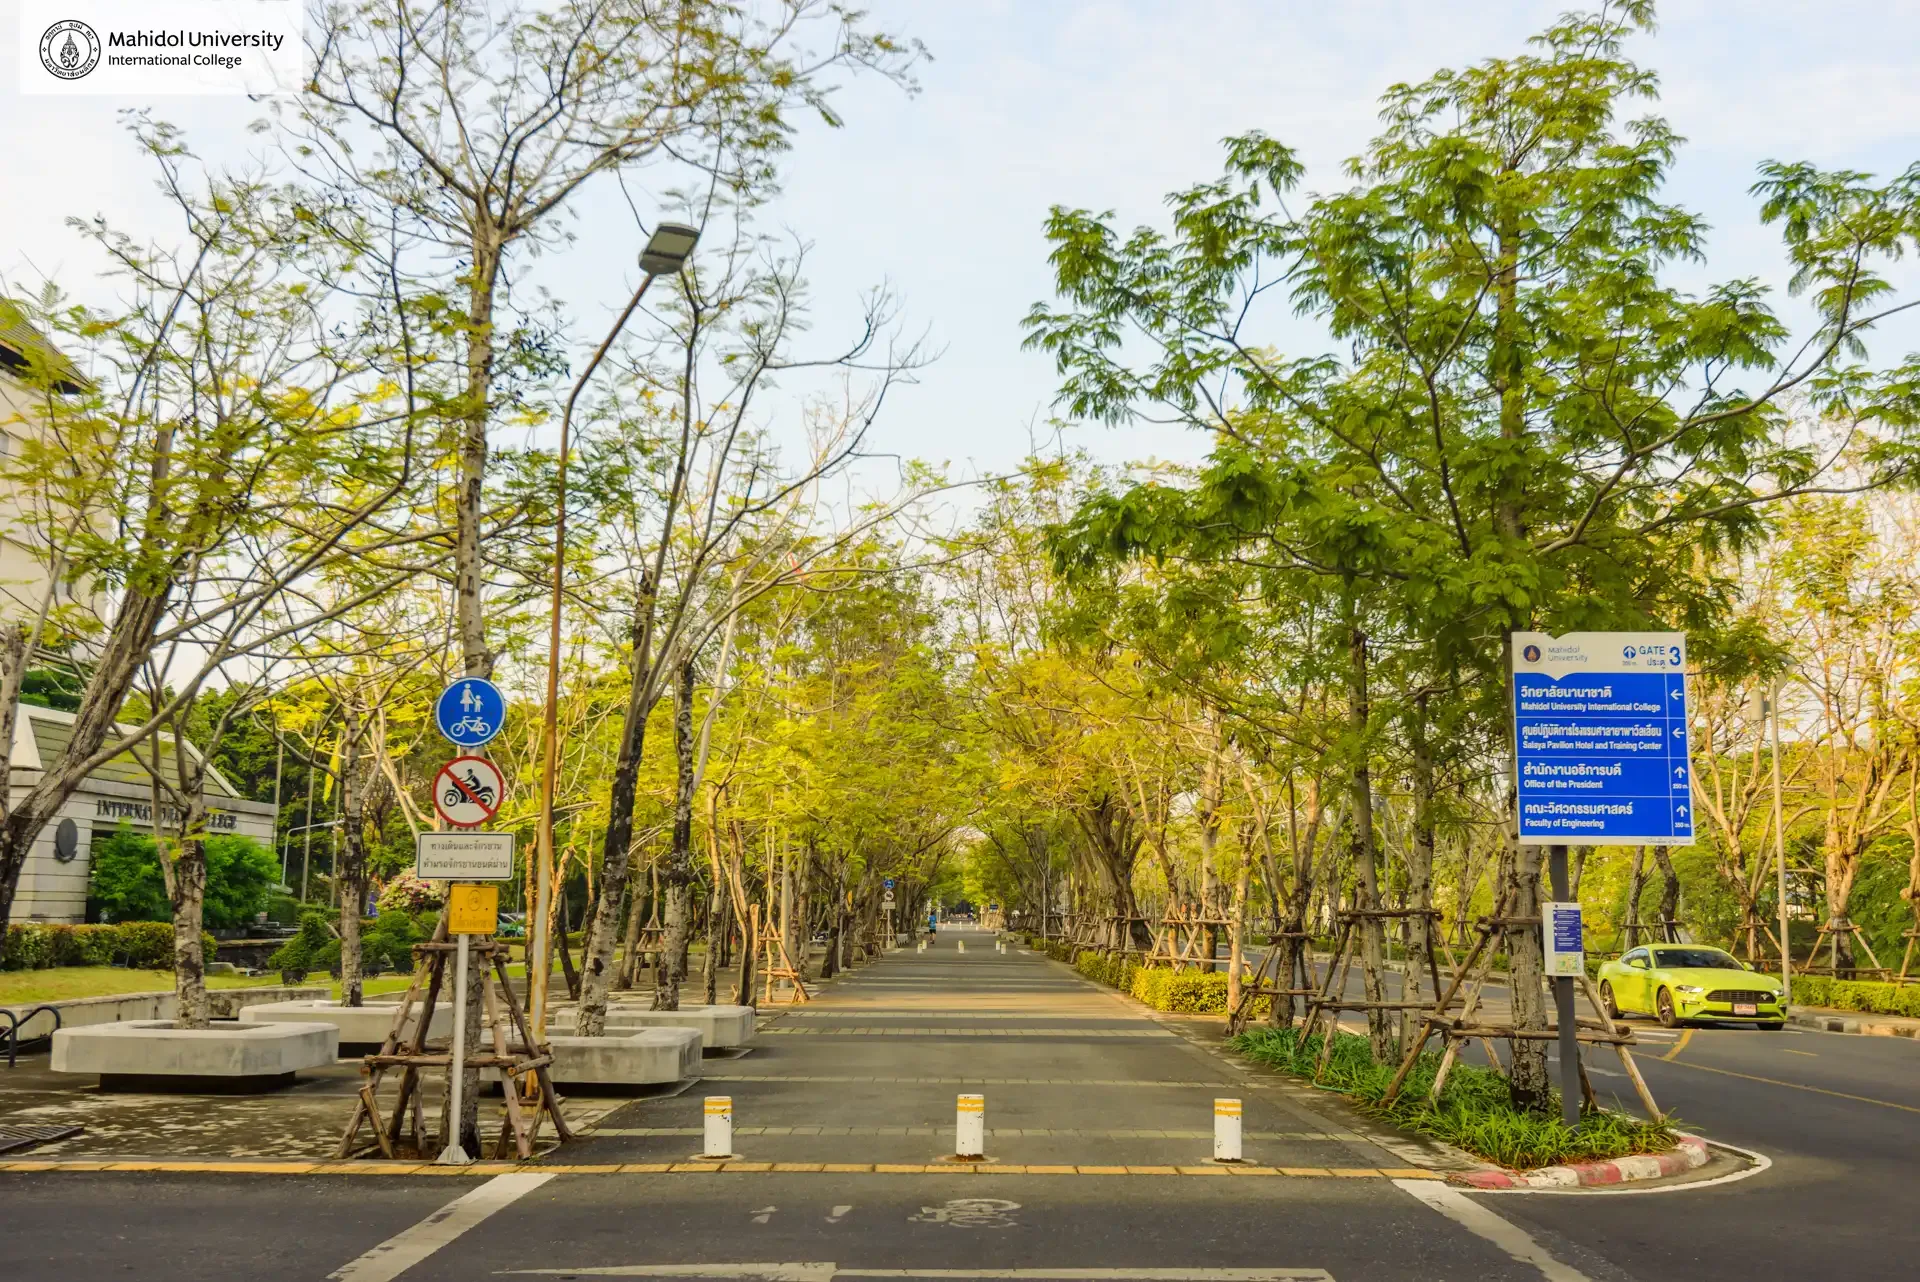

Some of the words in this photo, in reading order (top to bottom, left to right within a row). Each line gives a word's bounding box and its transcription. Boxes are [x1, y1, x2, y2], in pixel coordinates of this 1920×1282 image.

[1547, 644, 1580, 654] Mahidol
[1547, 654, 1588, 664] University
[1639, 645, 1666, 655] GATE
[1669, 646, 1681, 666] 3
[1646, 657, 1666, 670] ประตู
[1521, 685, 1612, 698] วิทยาลัยนานาชาติ
[1521, 702, 1550, 711] Mahidol
[1551, 702, 1586, 712] University
[1588, 702, 1632, 711] International
[1633, 703, 1661, 713] College
[1522, 741, 1546, 750] Salaya
[1547, 741, 1574, 749] Pavilion
[1575, 741, 1594, 749] Hotel
[1595, 741, 1608, 749] and
[1609, 741, 1637, 751] Training
[1638, 742, 1662, 750] Center
[1523, 761, 1622, 776] สำนักงานอธิการบดี
[1524, 780, 1546, 789] Office
[1547, 780, 1555, 789] of
[1555, 780, 1568, 789] the
[1568, 780, 1603, 789] President
[1524, 801, 1633, 815] คณะวิศวกรรมศาสตร์
[1525, 819, 1552, 829] Faculty
[1553, 819, 1561, 828] of
[1562, 819, 1605, 829] Engineering
